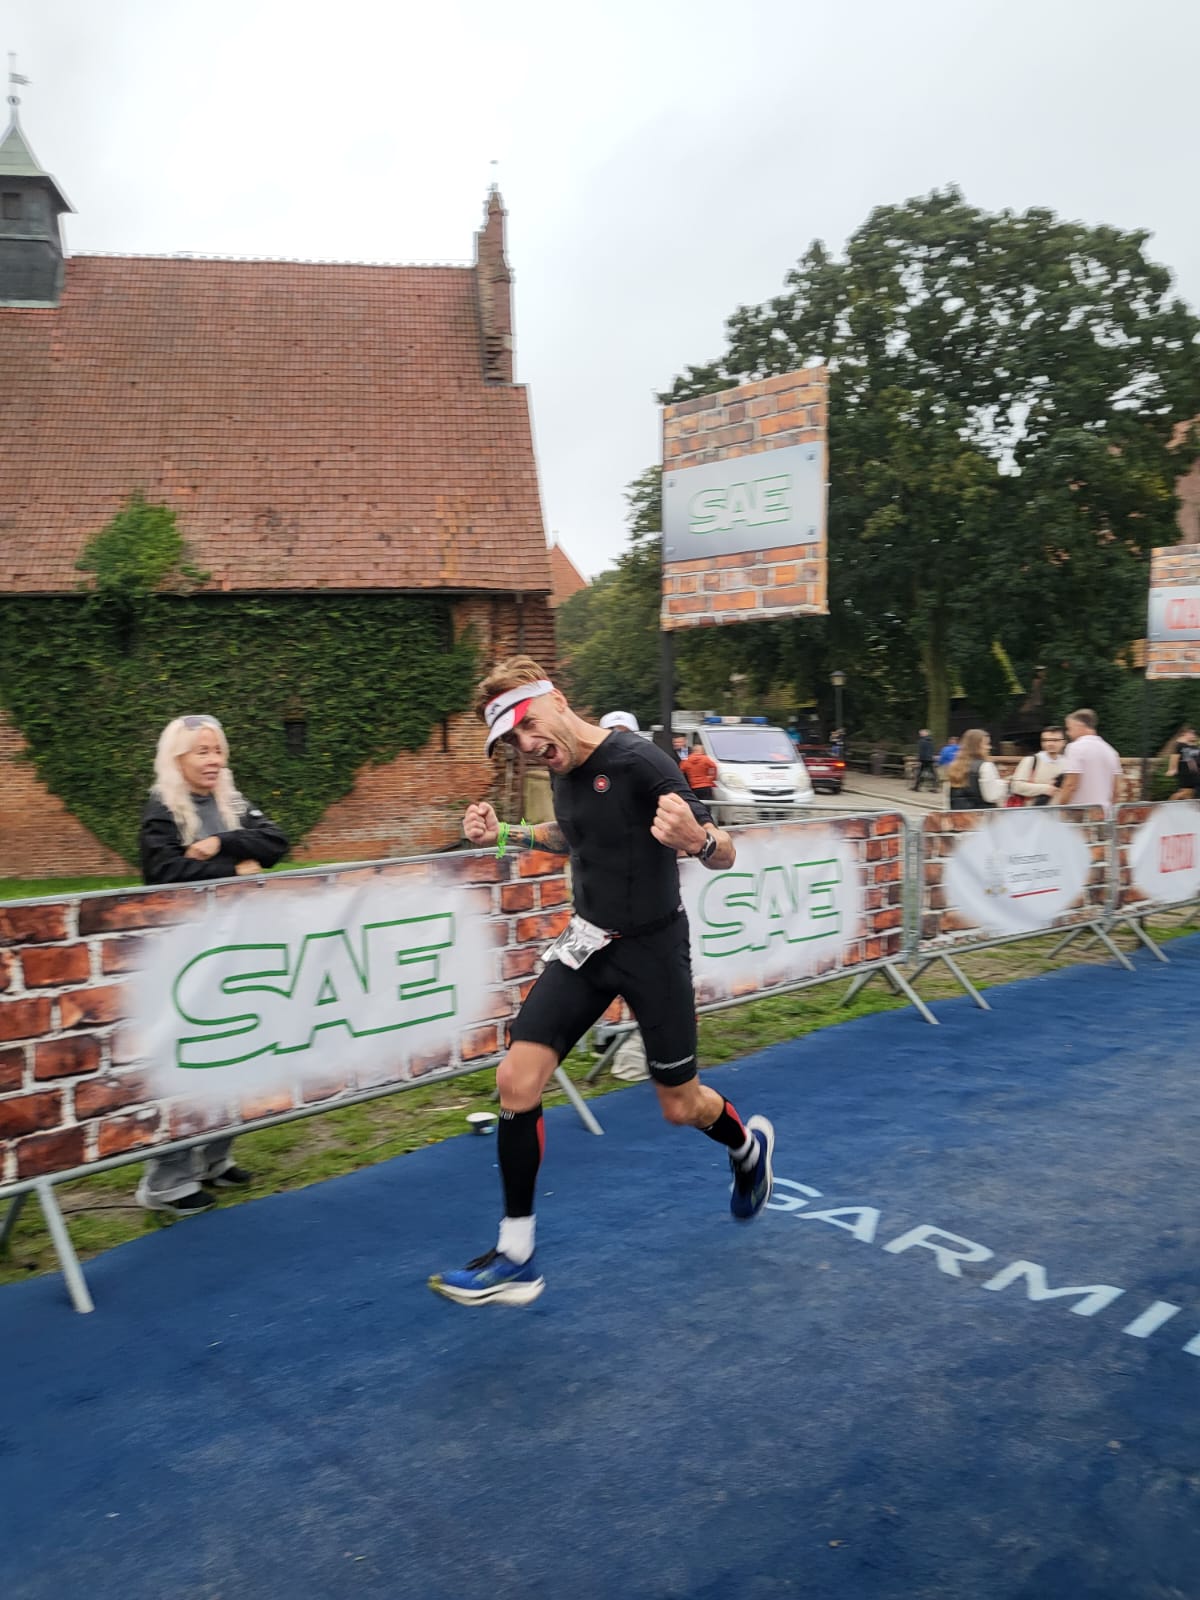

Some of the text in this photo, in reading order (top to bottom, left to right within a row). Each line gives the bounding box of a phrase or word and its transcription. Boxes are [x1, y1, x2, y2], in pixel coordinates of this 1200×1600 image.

[687, 473, 792, 535] SAE
[699, 858, 843, 958] SAE
[172, 912, 458, 1069] SAE
